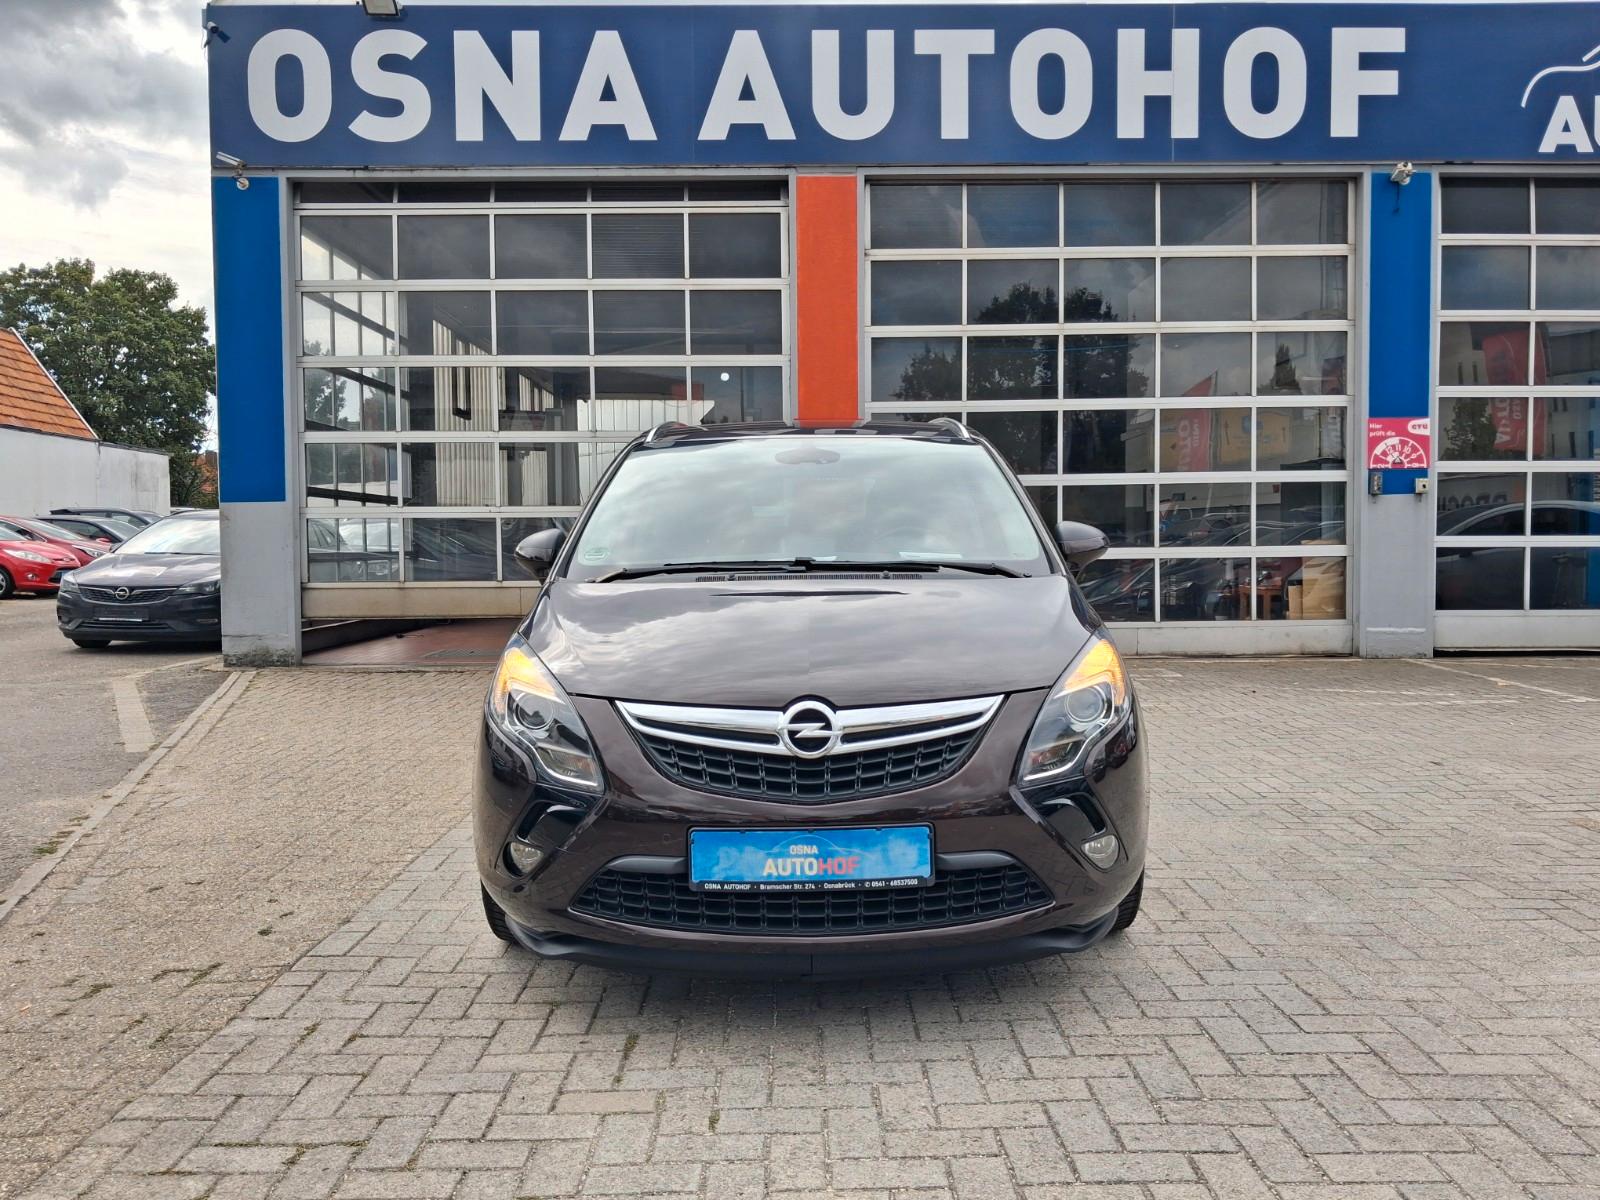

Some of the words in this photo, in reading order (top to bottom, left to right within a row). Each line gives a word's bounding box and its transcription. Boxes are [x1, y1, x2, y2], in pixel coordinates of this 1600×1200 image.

[247, 28, 657, 143] OSNA
[697, 26, 1405, 140] AUTOHOF
[1538, 95, 1600, 153] A
[762, 856, 861, 876] AUTOHOF
[789, 845, 819, 854] OSNA
